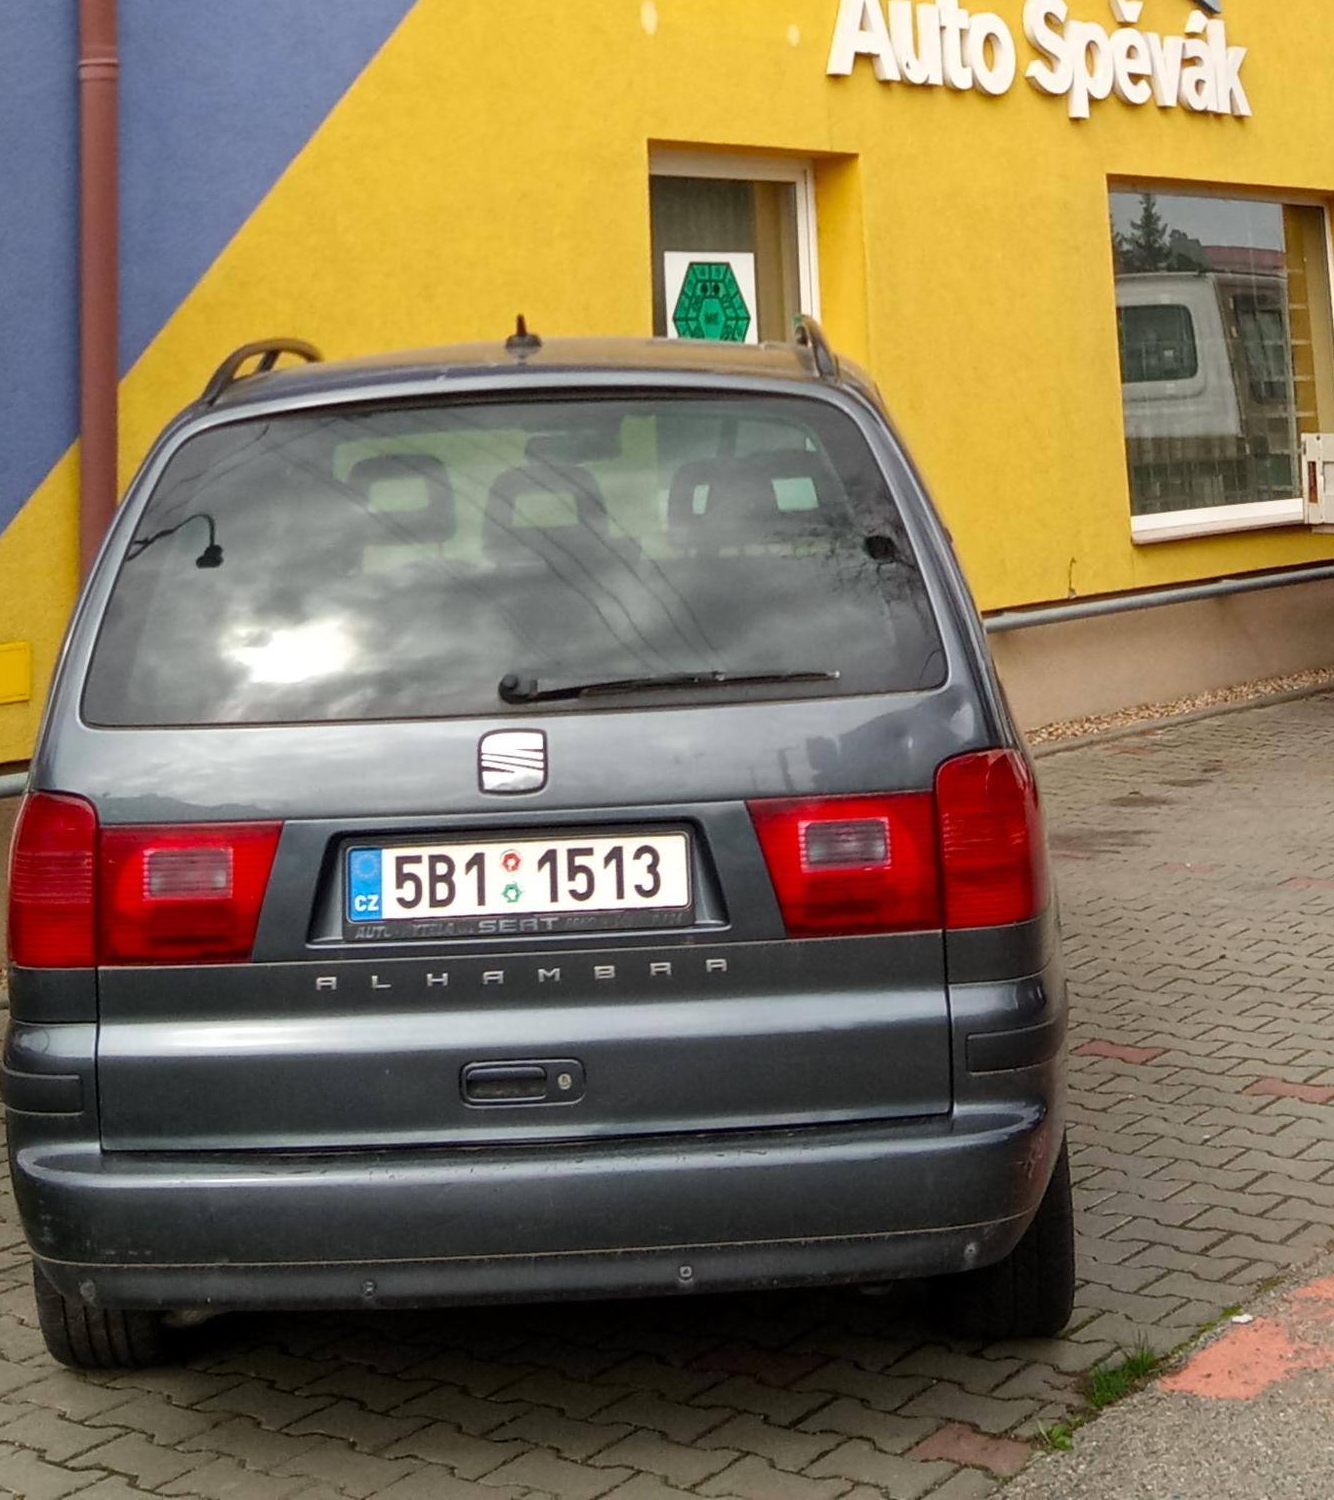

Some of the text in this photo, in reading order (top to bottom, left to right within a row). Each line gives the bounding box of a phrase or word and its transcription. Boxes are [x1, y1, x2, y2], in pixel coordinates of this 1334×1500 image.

[354, 844, 662, 912] CZ 5B1 1513
[477, 915, 559, 935] SEAT
[315, 957, 729, 991] ALHAMBRA
